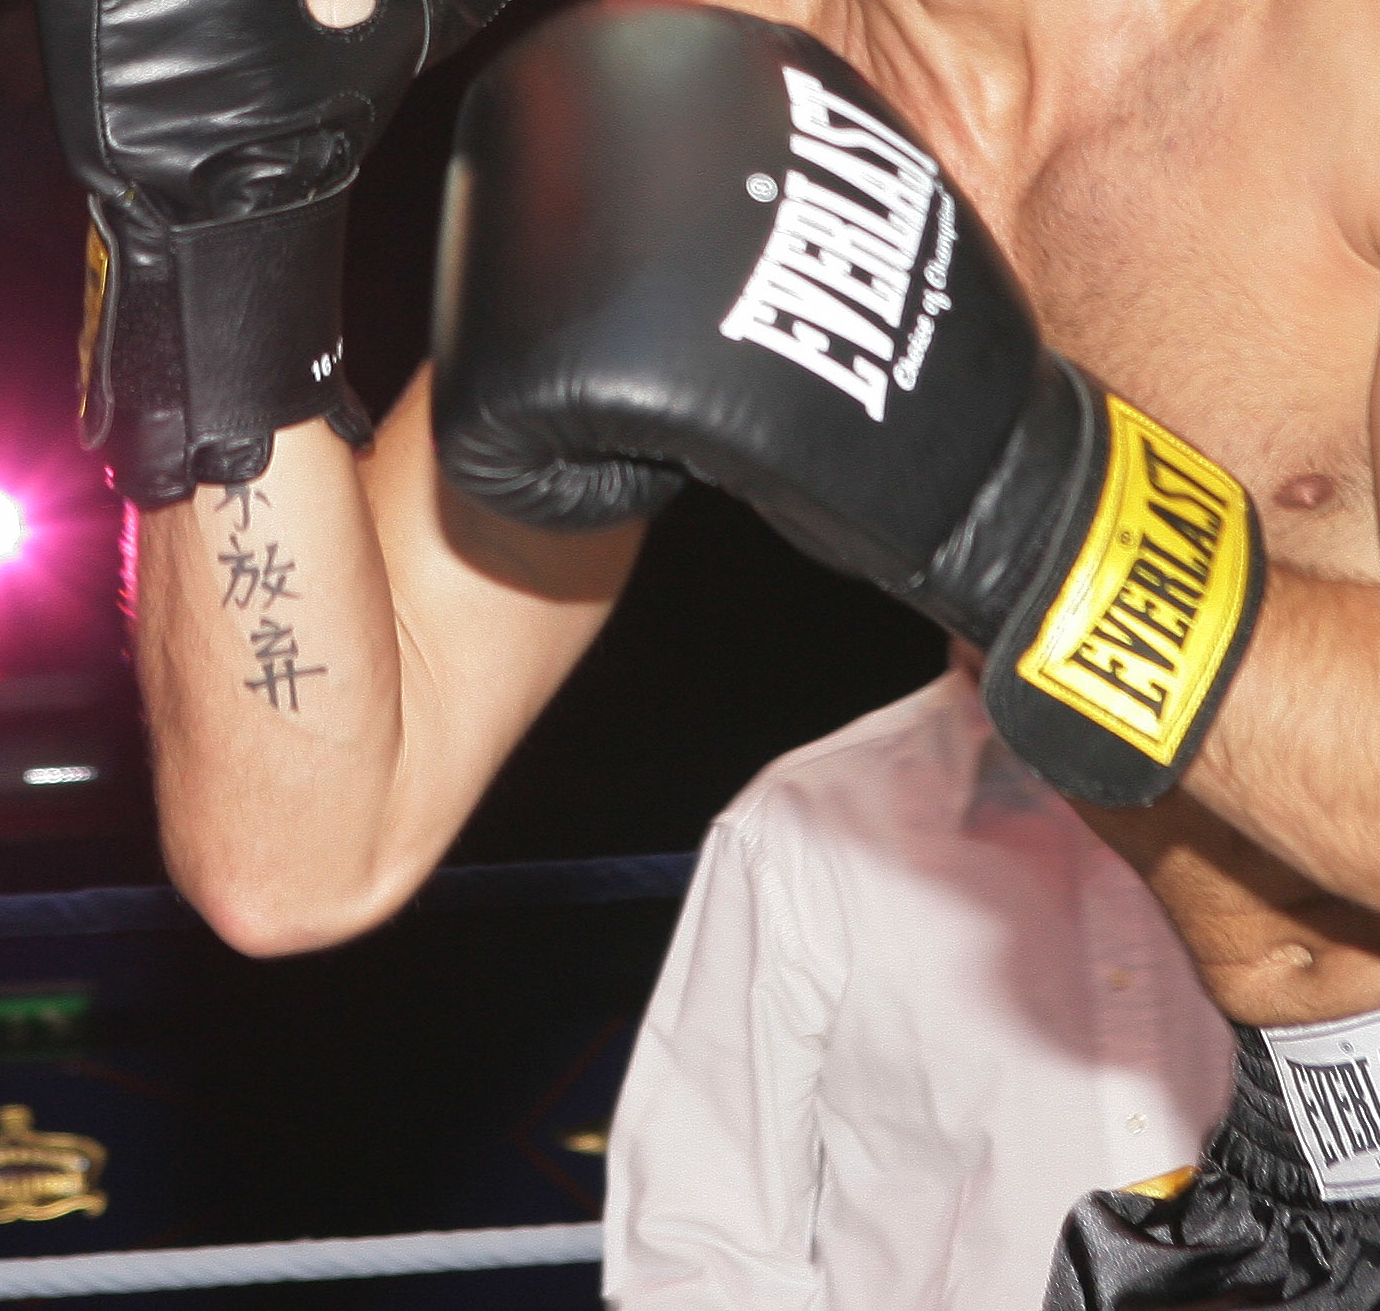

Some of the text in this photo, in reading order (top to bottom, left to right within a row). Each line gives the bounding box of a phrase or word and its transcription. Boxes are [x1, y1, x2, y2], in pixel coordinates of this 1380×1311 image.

[719, 65, 938, 423] EVERLAST
[921, 288, 953, 316] of
[1067, 436, 1228, 721] EVERLAST
